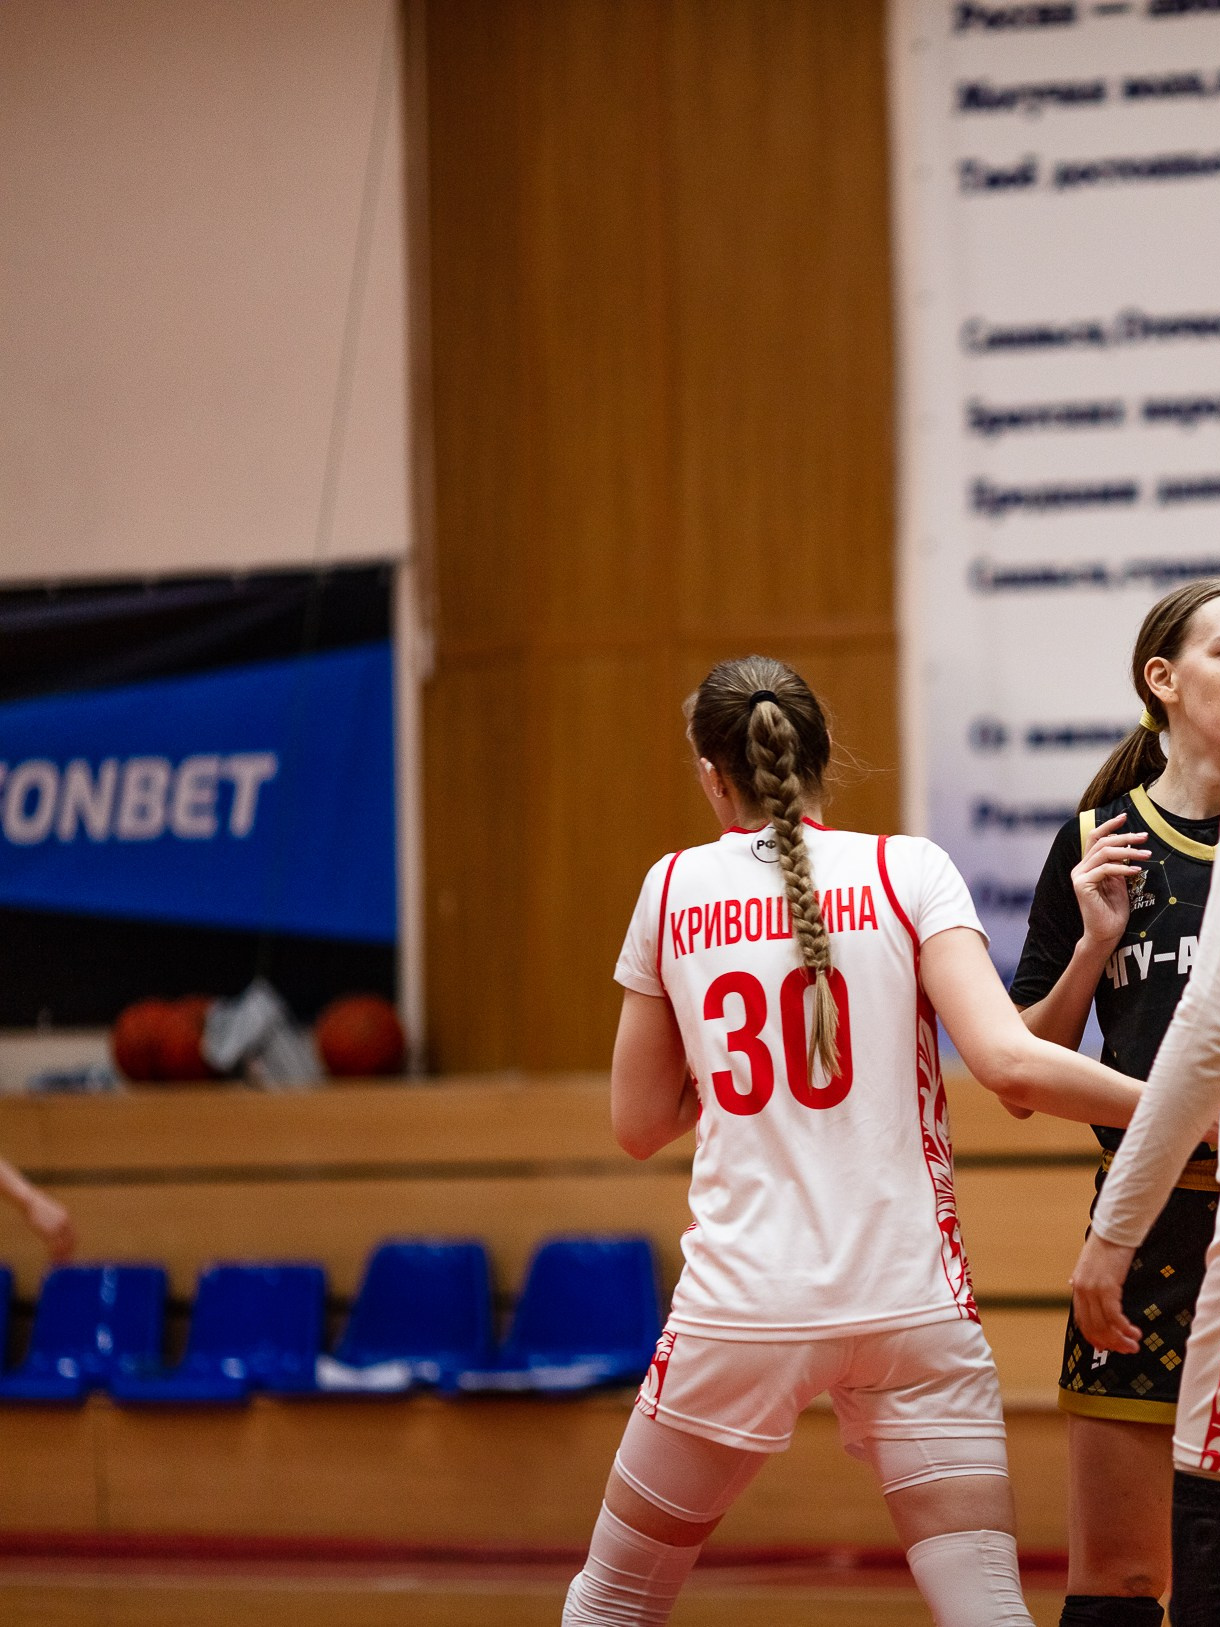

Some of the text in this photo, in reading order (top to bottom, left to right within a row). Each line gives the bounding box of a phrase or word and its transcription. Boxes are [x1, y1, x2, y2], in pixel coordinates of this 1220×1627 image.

[0, 751, 278, 845] ONBET
[670, 885, 879, 960] КРИВОШИНА
[703, 970, 854, 1117] 30
